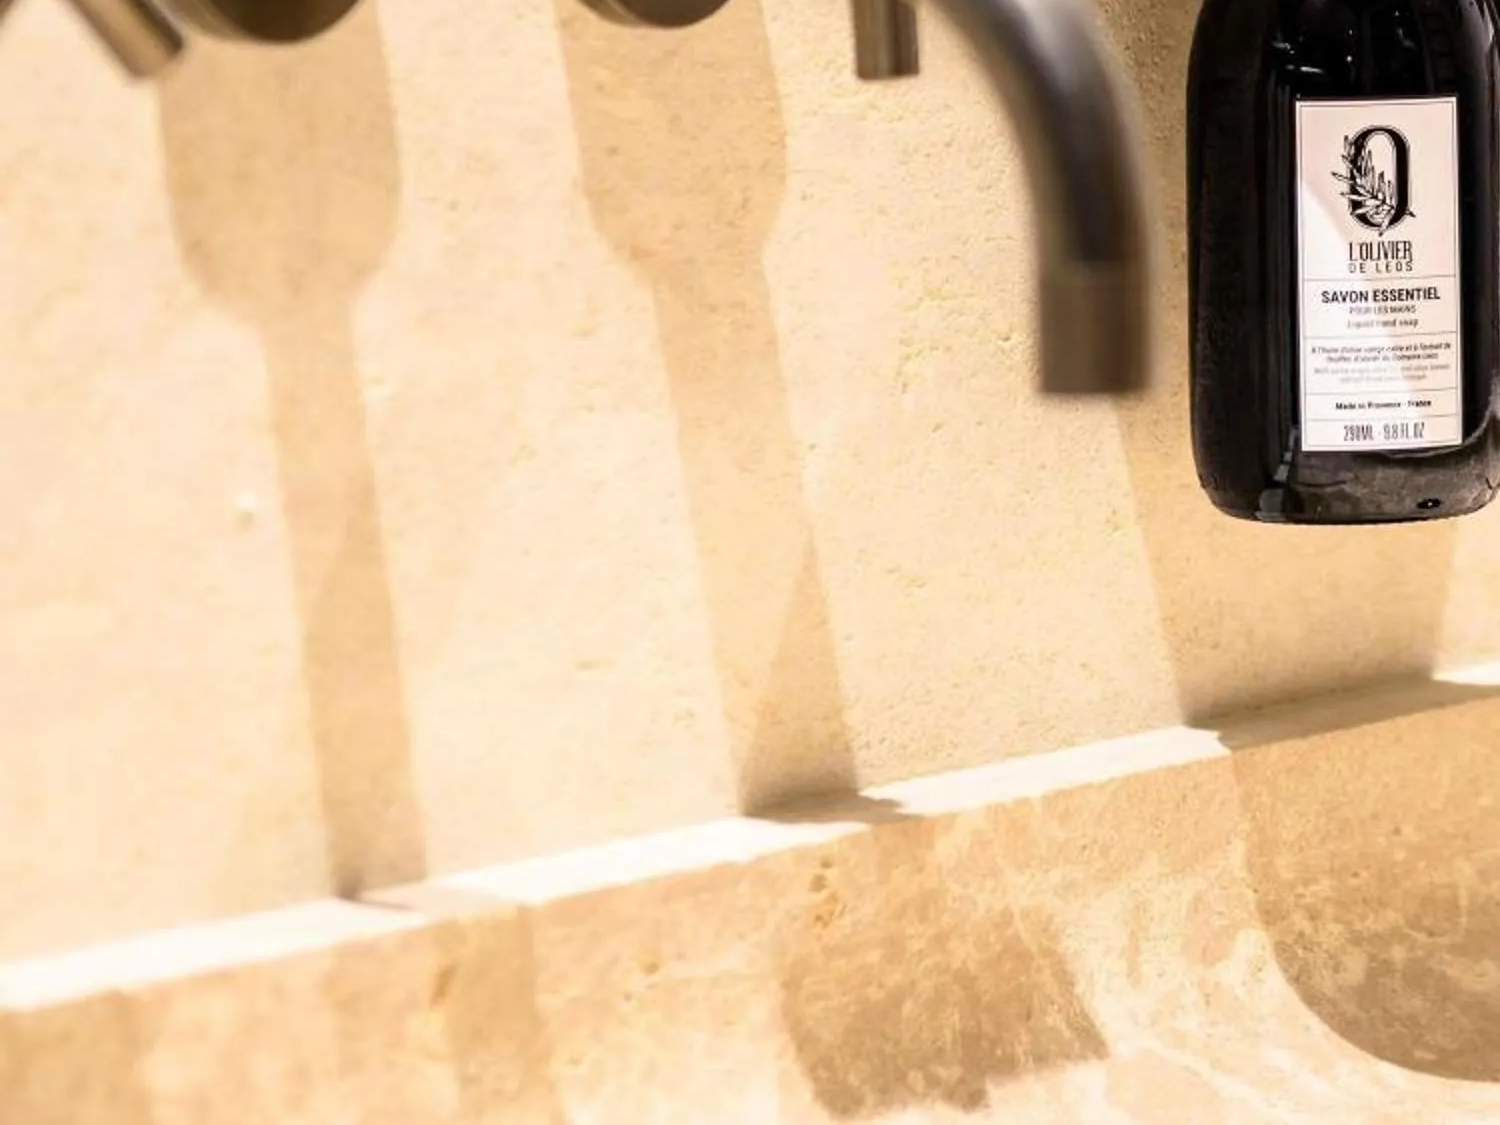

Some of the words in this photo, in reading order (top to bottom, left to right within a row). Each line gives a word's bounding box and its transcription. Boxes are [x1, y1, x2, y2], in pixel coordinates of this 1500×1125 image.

[1348, 262, 1366, 274] DE
[1375, 261, 1413, 273] LEOS
[1321, 290, 1369, 304] SAVON
[1373, 286, 1441, 302] ESSENTIEL
